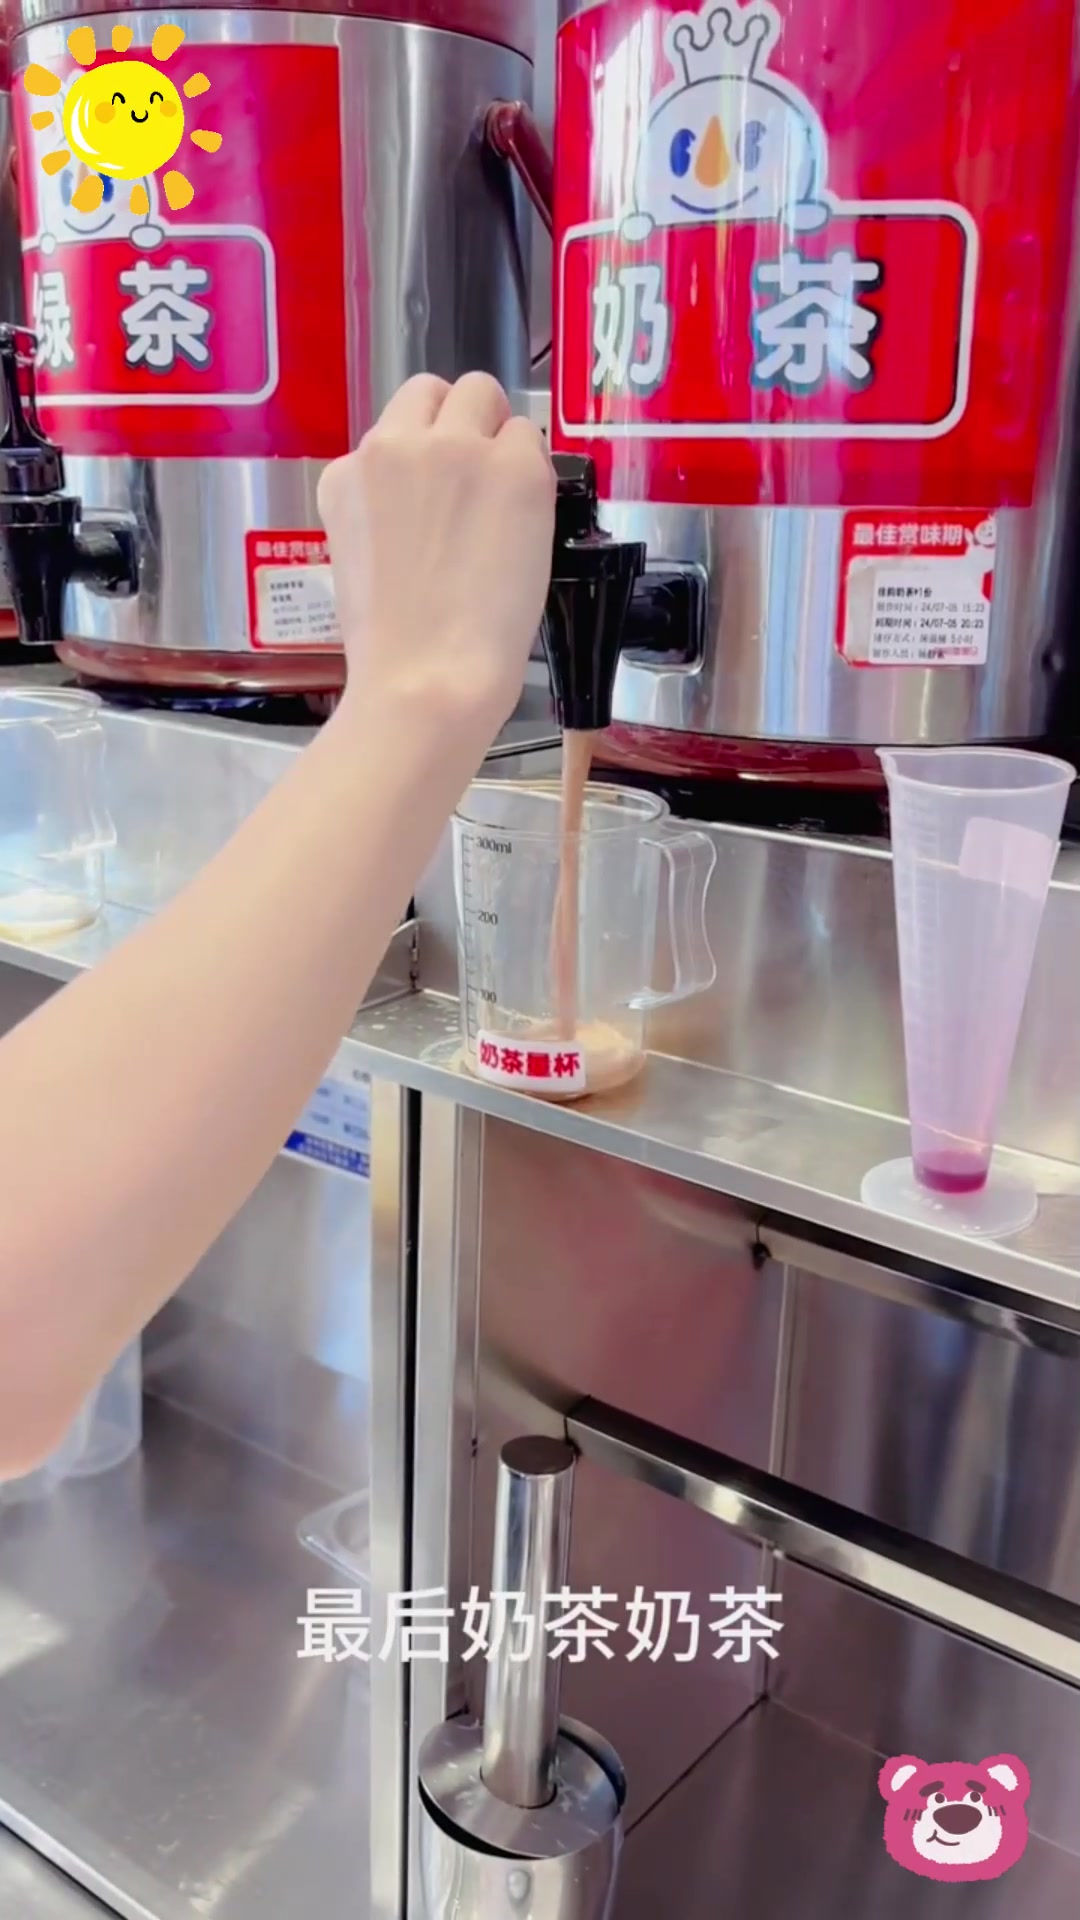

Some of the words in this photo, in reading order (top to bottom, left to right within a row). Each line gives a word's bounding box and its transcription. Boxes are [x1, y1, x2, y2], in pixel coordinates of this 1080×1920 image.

[592, 250, 880, 388] 奶茶
[853, 522, 963, 546] 最佳赏味期
[475, 836, 512, 854] 300ml
[477, 910, 499, 926] 200
[479, 1039, 581, 1079] 奶茶量杯
